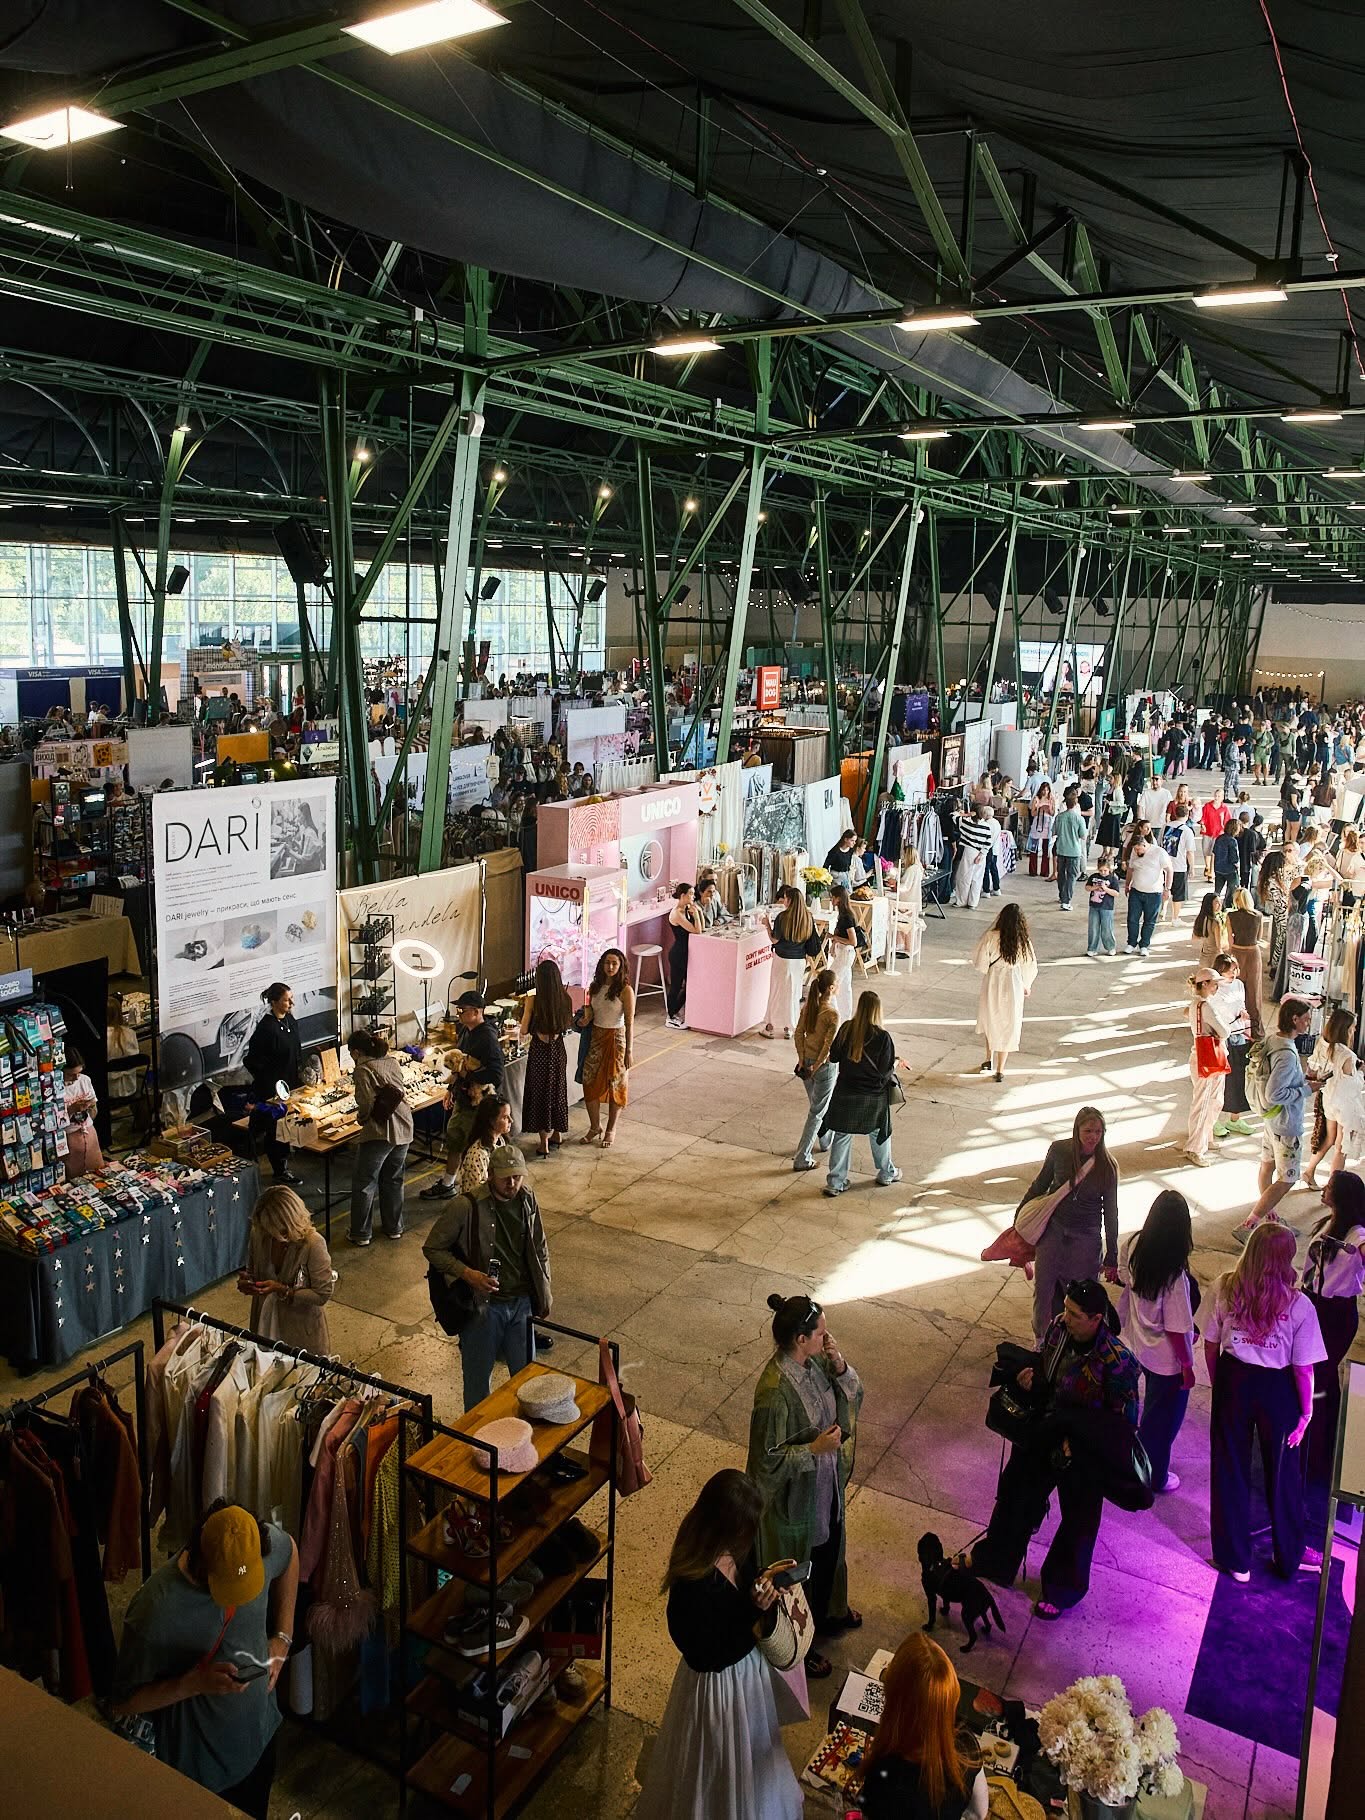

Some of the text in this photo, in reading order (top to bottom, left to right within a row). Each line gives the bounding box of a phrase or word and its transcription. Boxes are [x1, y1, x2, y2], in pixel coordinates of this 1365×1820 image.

[641, 797, 681, 822] UNICO
[535, 882, 580, 900] UNICO
[165, 913, 183, 922] DARI
[184, 909, 209, 921] jewelry
[261, 896, 281, 904] мають
[352, 890, 408, 922] Bella
